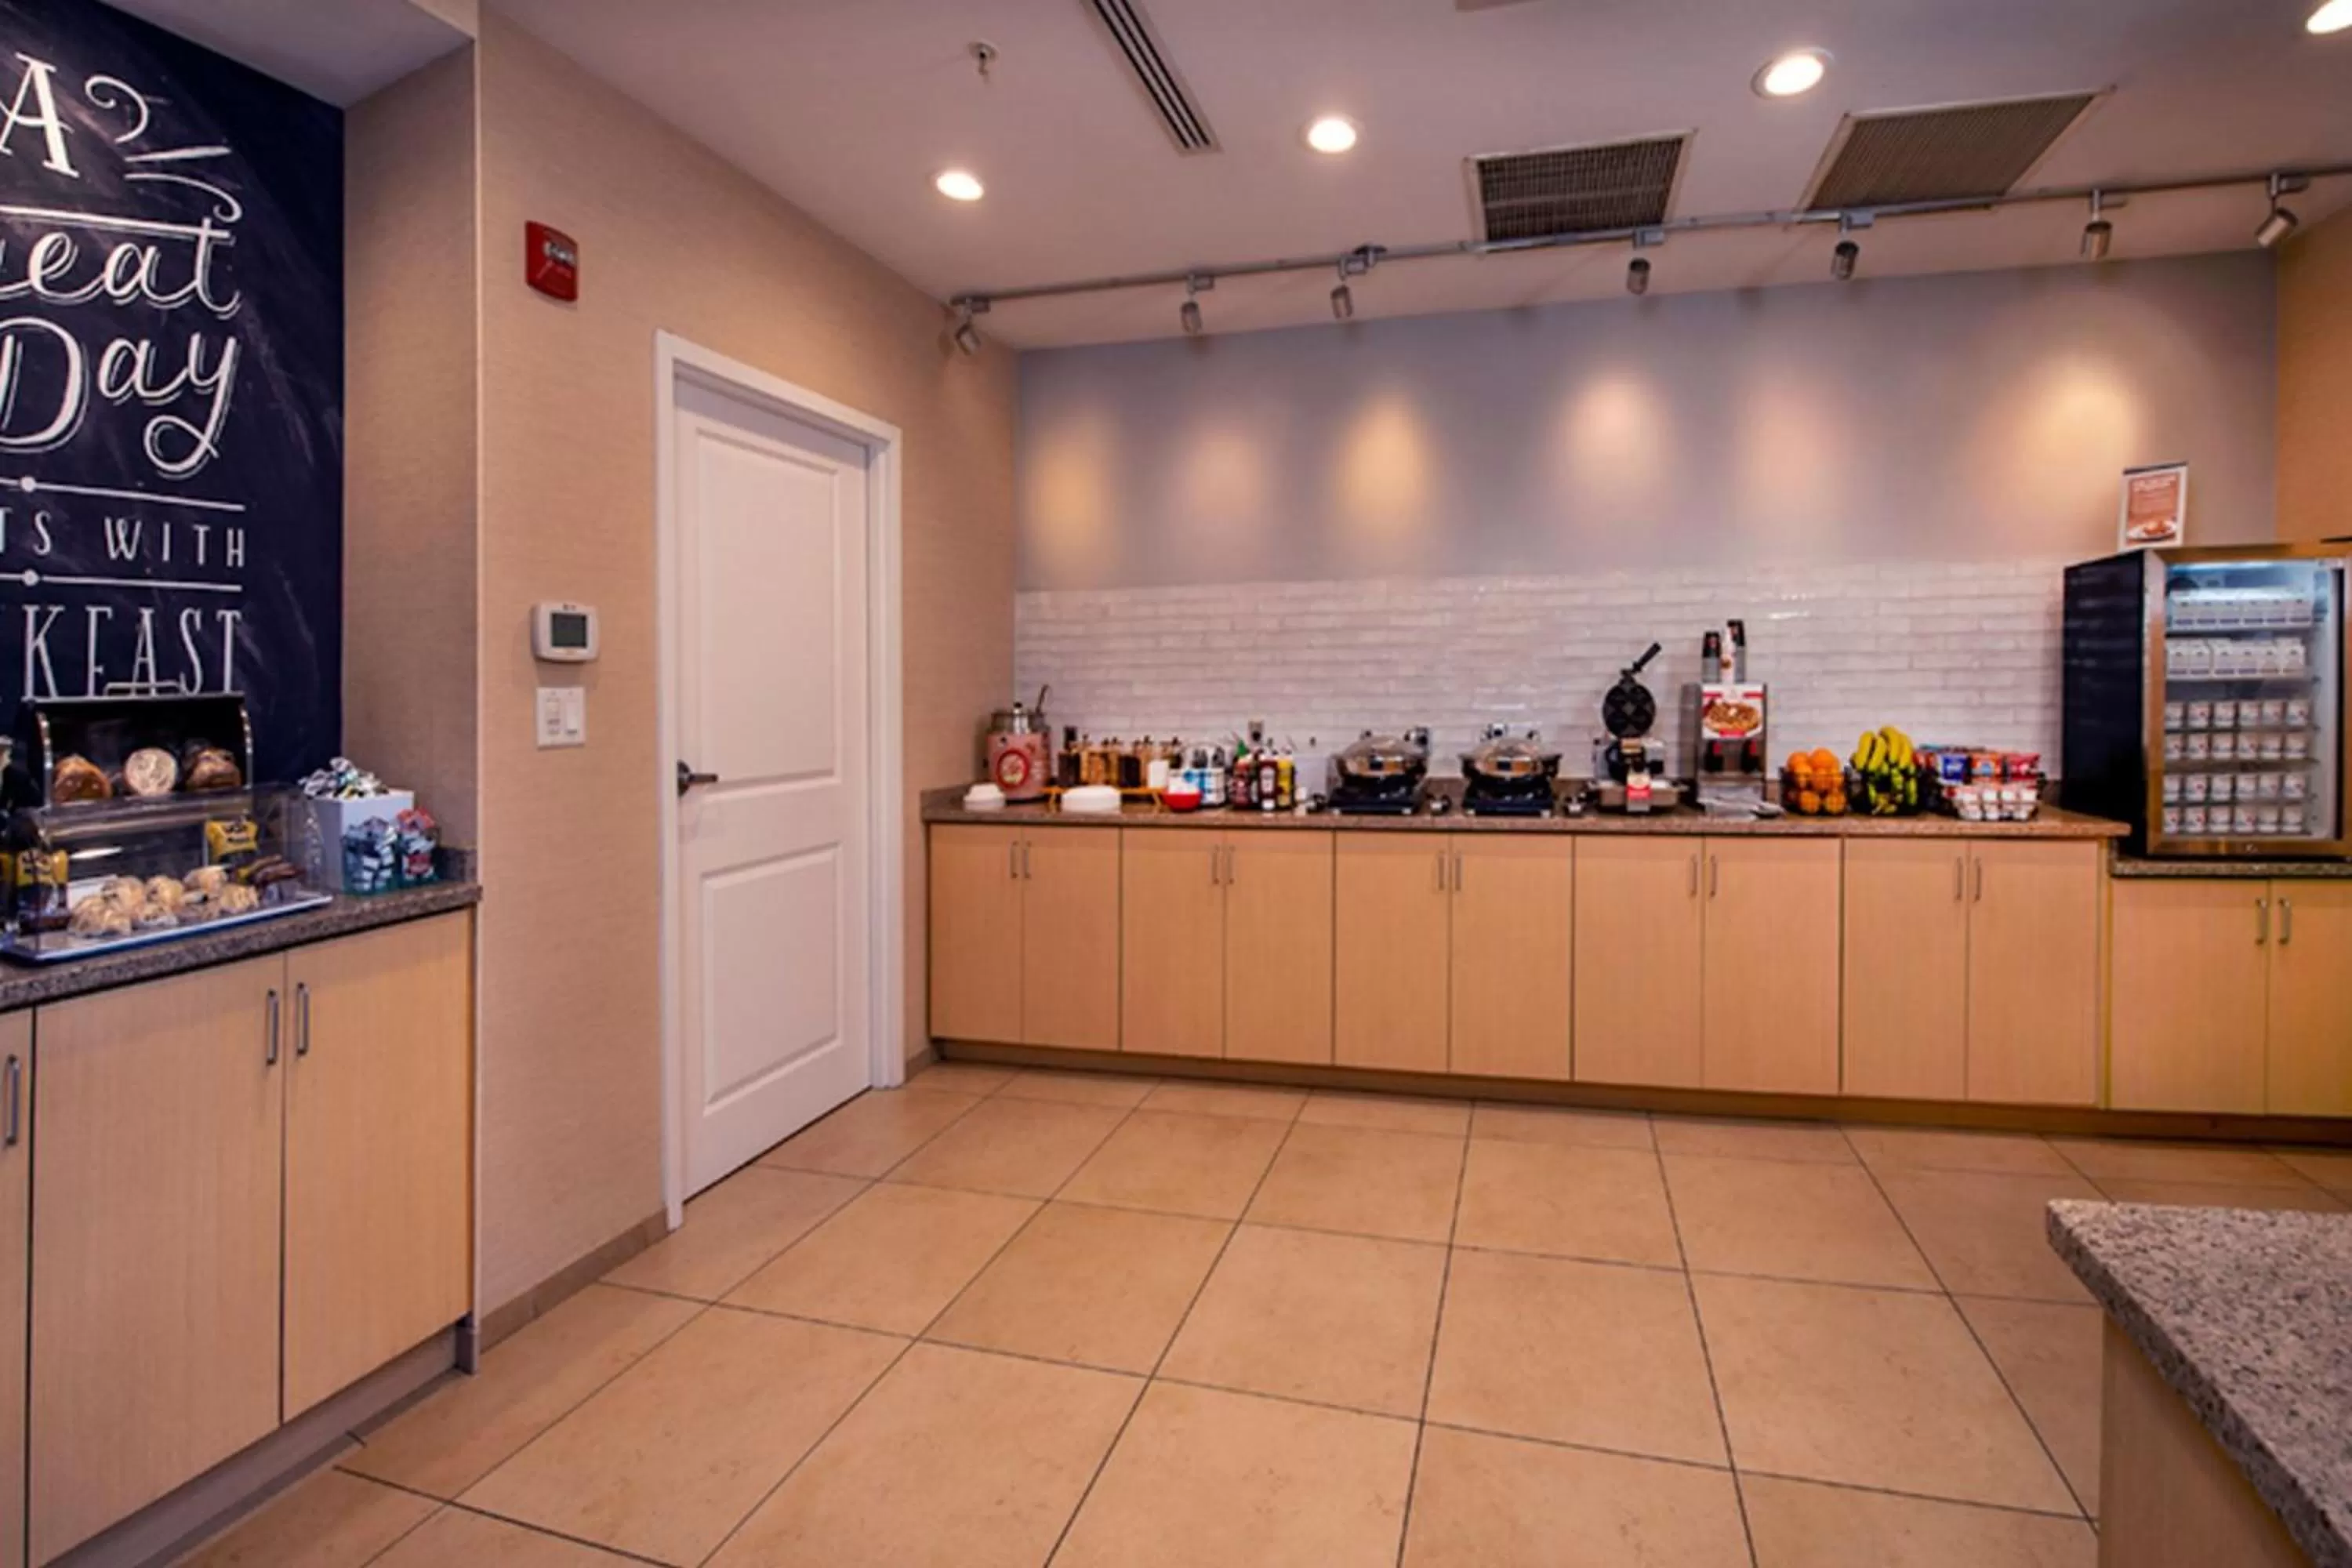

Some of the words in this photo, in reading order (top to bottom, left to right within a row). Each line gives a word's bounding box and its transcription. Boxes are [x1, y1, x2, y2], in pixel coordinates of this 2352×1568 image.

[0, 52, 79, 178] A
[0, 216, 241, 318] eat
[0, 317, 241, 478] Day
[104, 517, 244, 568] WITH
